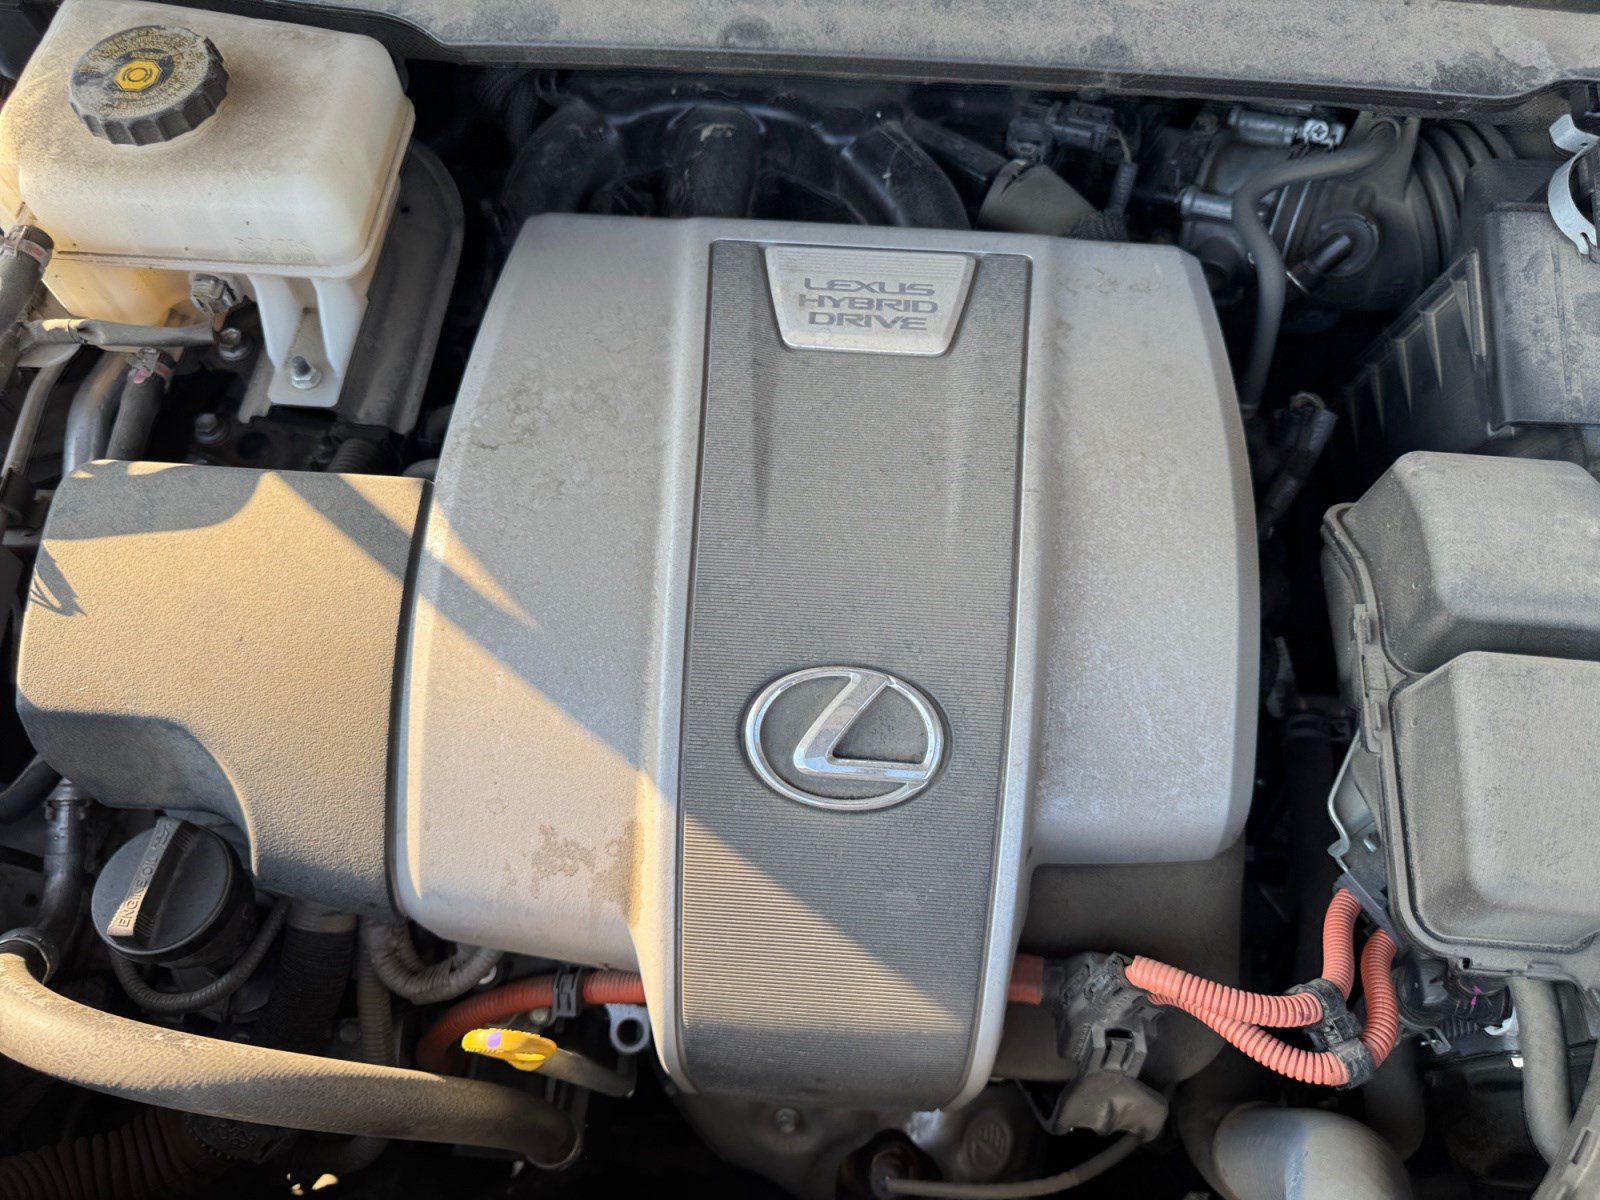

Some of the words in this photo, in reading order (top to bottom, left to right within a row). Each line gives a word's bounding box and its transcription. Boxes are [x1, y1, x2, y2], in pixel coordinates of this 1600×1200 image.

[804, 278, 935, 296] LEXUS
[798, 294, 938, 313] HYBRID
[808, 311, 927, 330] DRIVE
[117, 879, 148, 928] ENGINE
[142, 854, 159, 876] OIL
